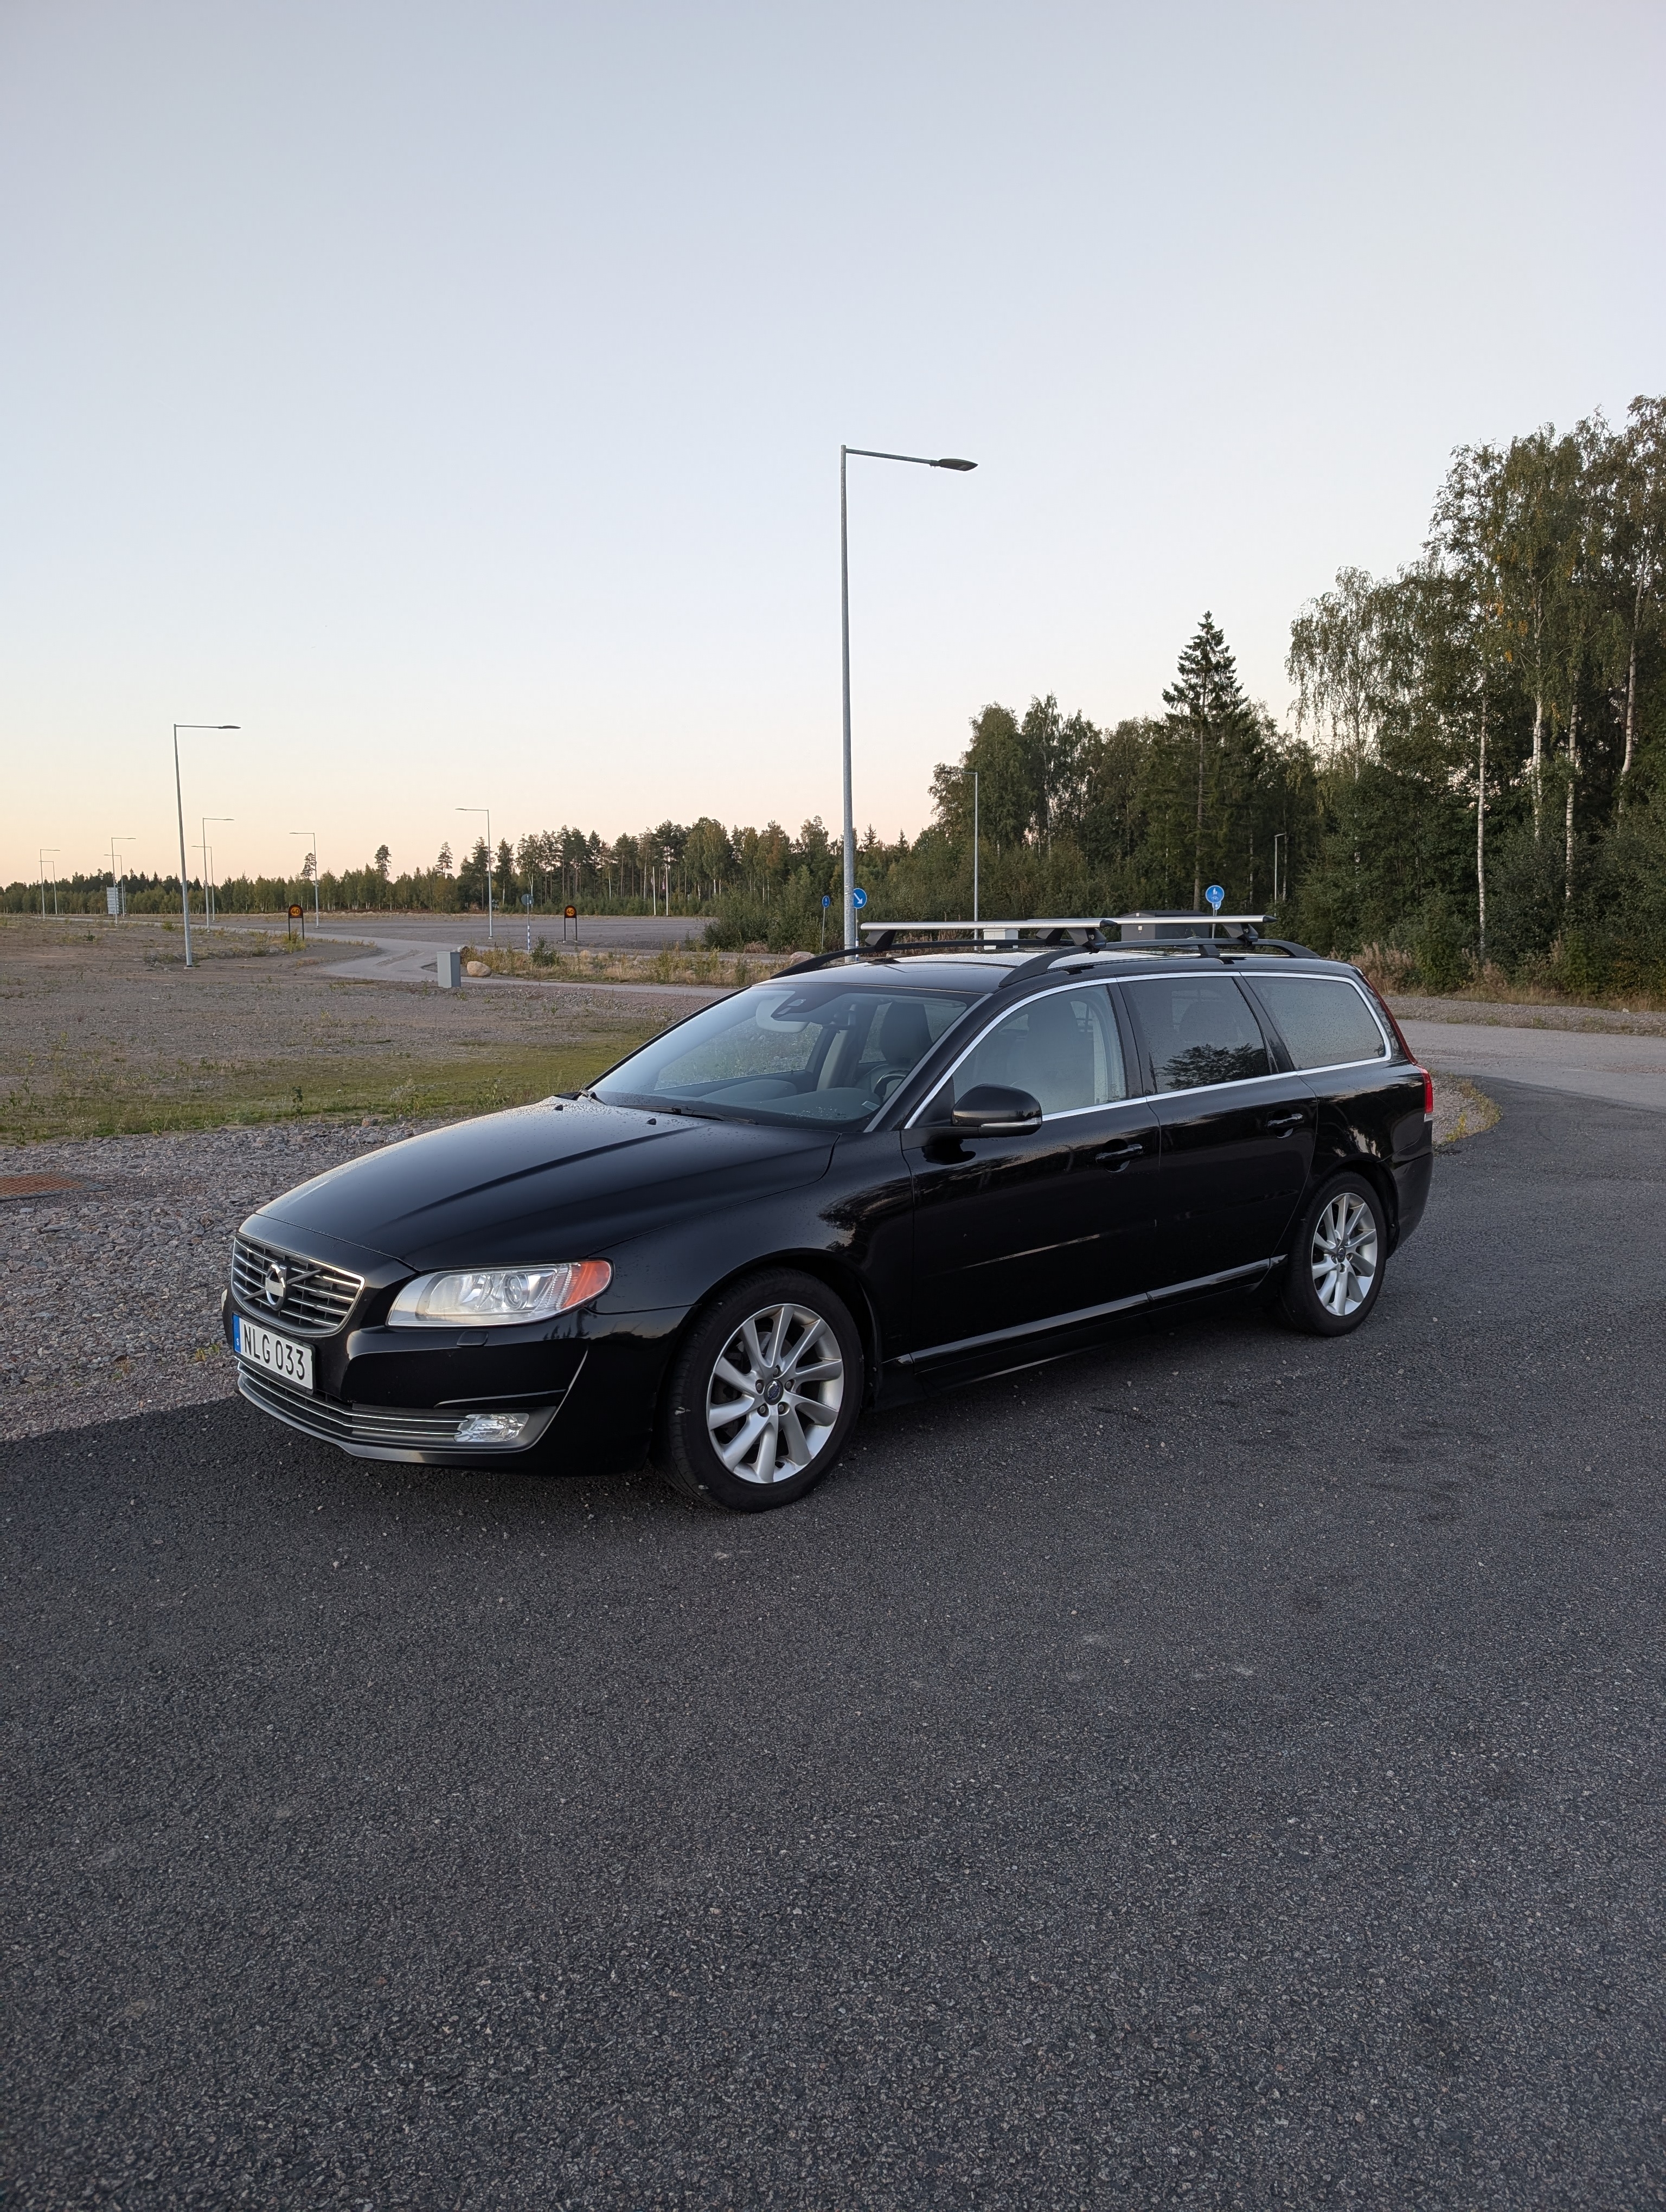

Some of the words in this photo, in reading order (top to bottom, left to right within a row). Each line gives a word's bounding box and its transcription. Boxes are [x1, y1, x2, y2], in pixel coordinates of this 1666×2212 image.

[236, 1338, 239, 1346] S
[244, 1323, 271, 1364] NLG
[275, 1339, 305, 1380] 033
